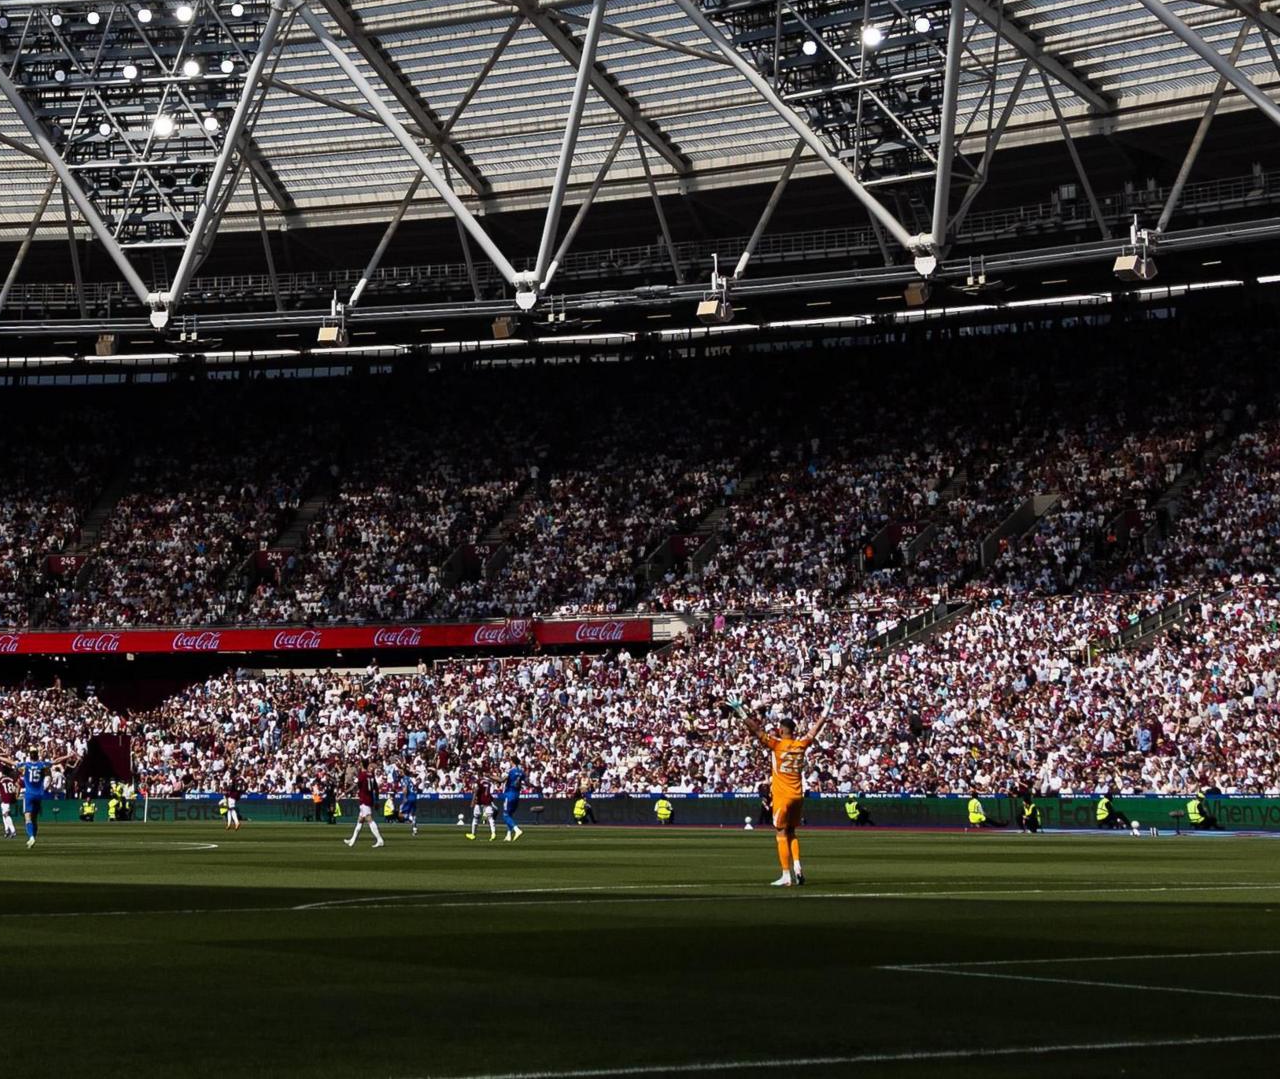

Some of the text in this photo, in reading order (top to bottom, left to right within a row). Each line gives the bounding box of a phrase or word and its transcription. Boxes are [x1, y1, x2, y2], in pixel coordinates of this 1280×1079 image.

[901, 525, 917, 535] 241
[684, 537, 699, 546] 242
[474, 545, 490, 554] 243
[60, 557, 76, 565] 245
[267, 552, 282, 561] 244
[29, 771, 41, 782] 15
[2, 781, 14, 792] 18
